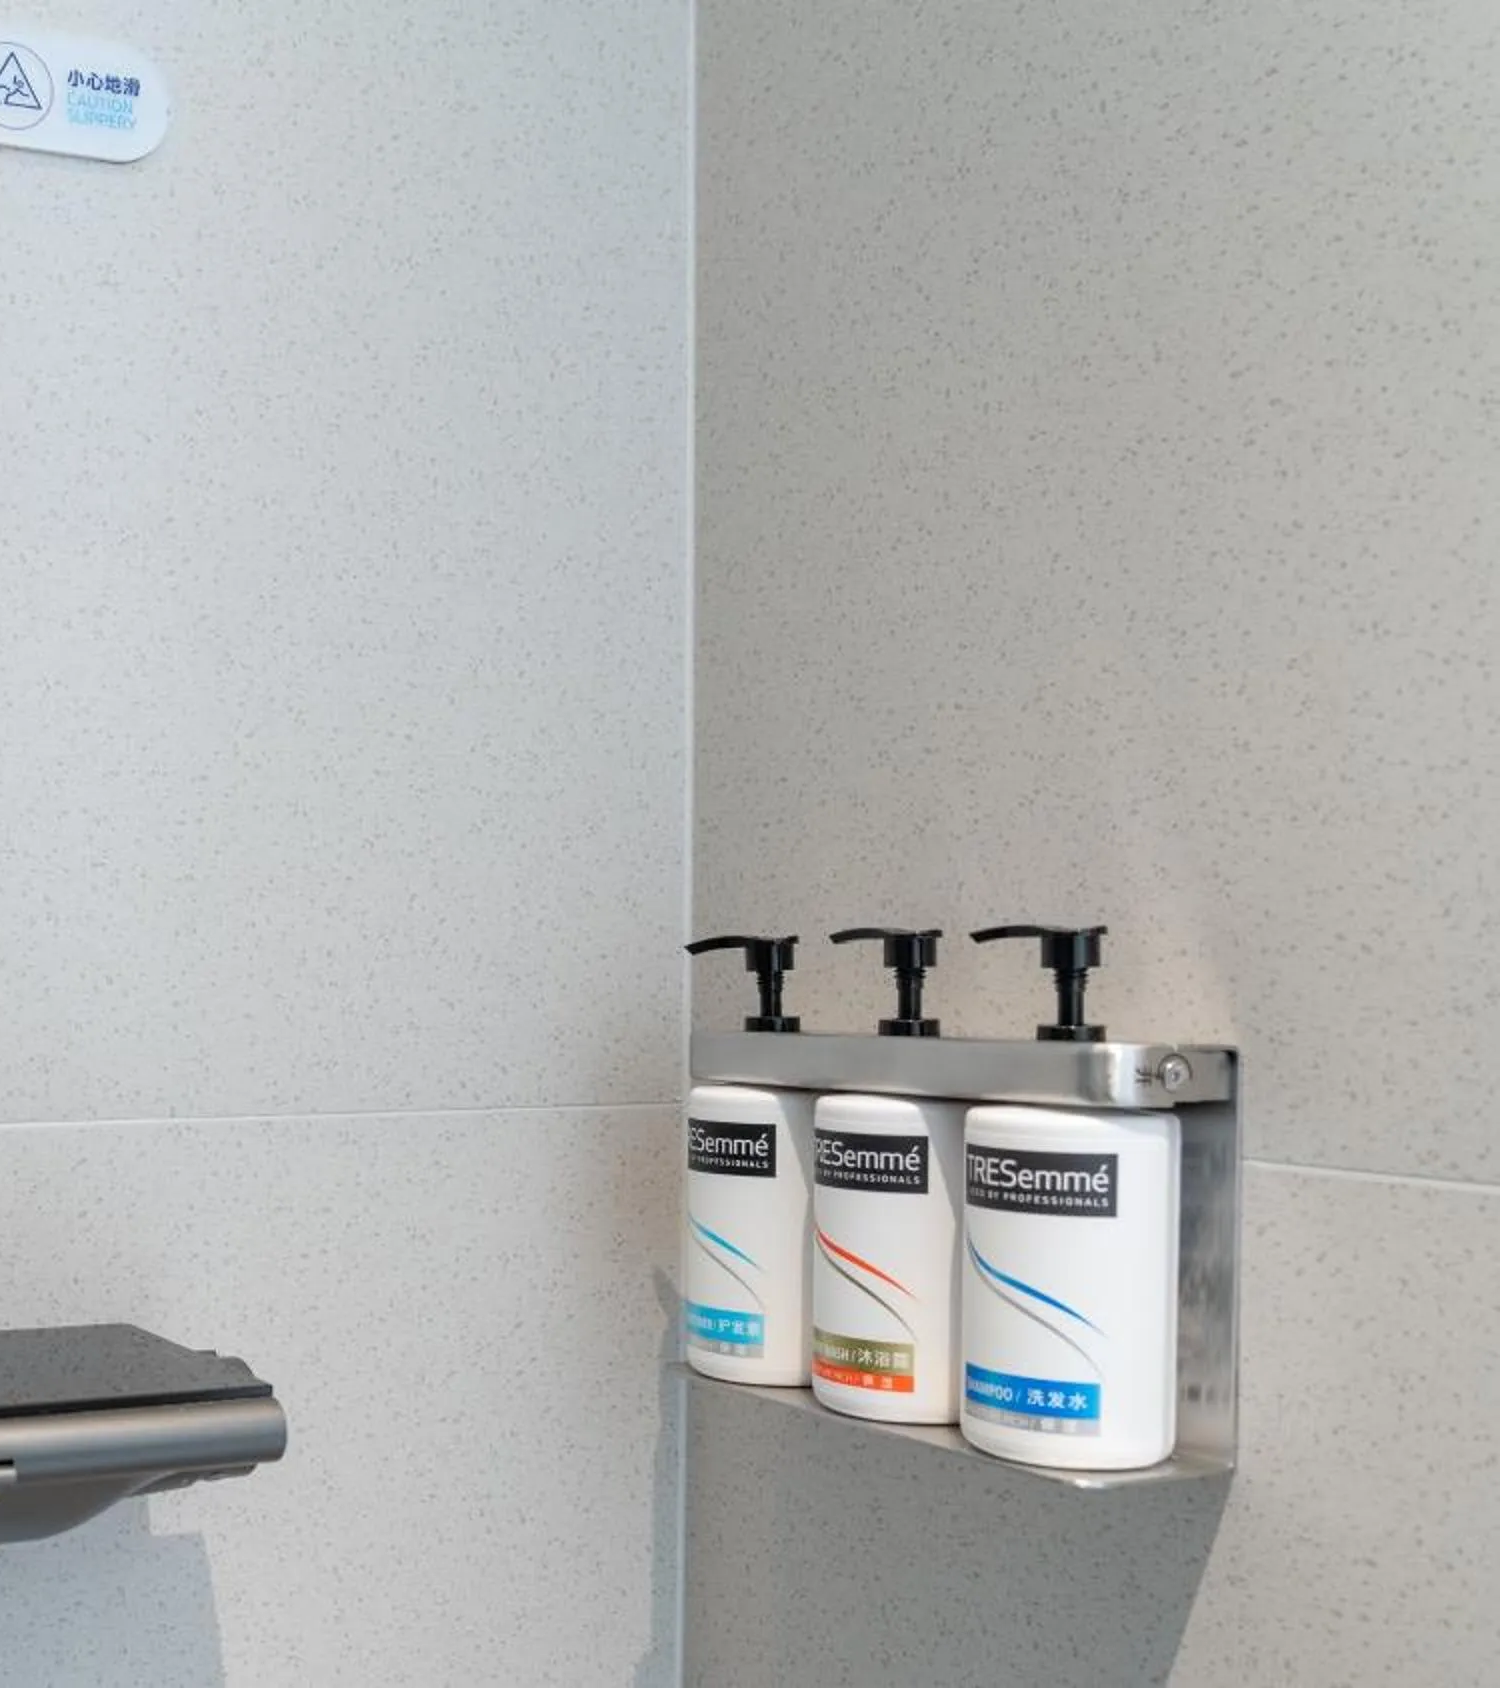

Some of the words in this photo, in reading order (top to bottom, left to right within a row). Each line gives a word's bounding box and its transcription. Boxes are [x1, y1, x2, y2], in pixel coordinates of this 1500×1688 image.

[67, 69, 140, 97] 小心地滑
[67, 91, 133, 114] CAUTION
[689, 1127, 769, 1157] ESemmé
[967, 1154, 1110, 1193] TRESemmé
[1003, 1192, 1109, 1208] PROFESSIONALS
[1027, 1387, 1089, 1411] 洗发水
